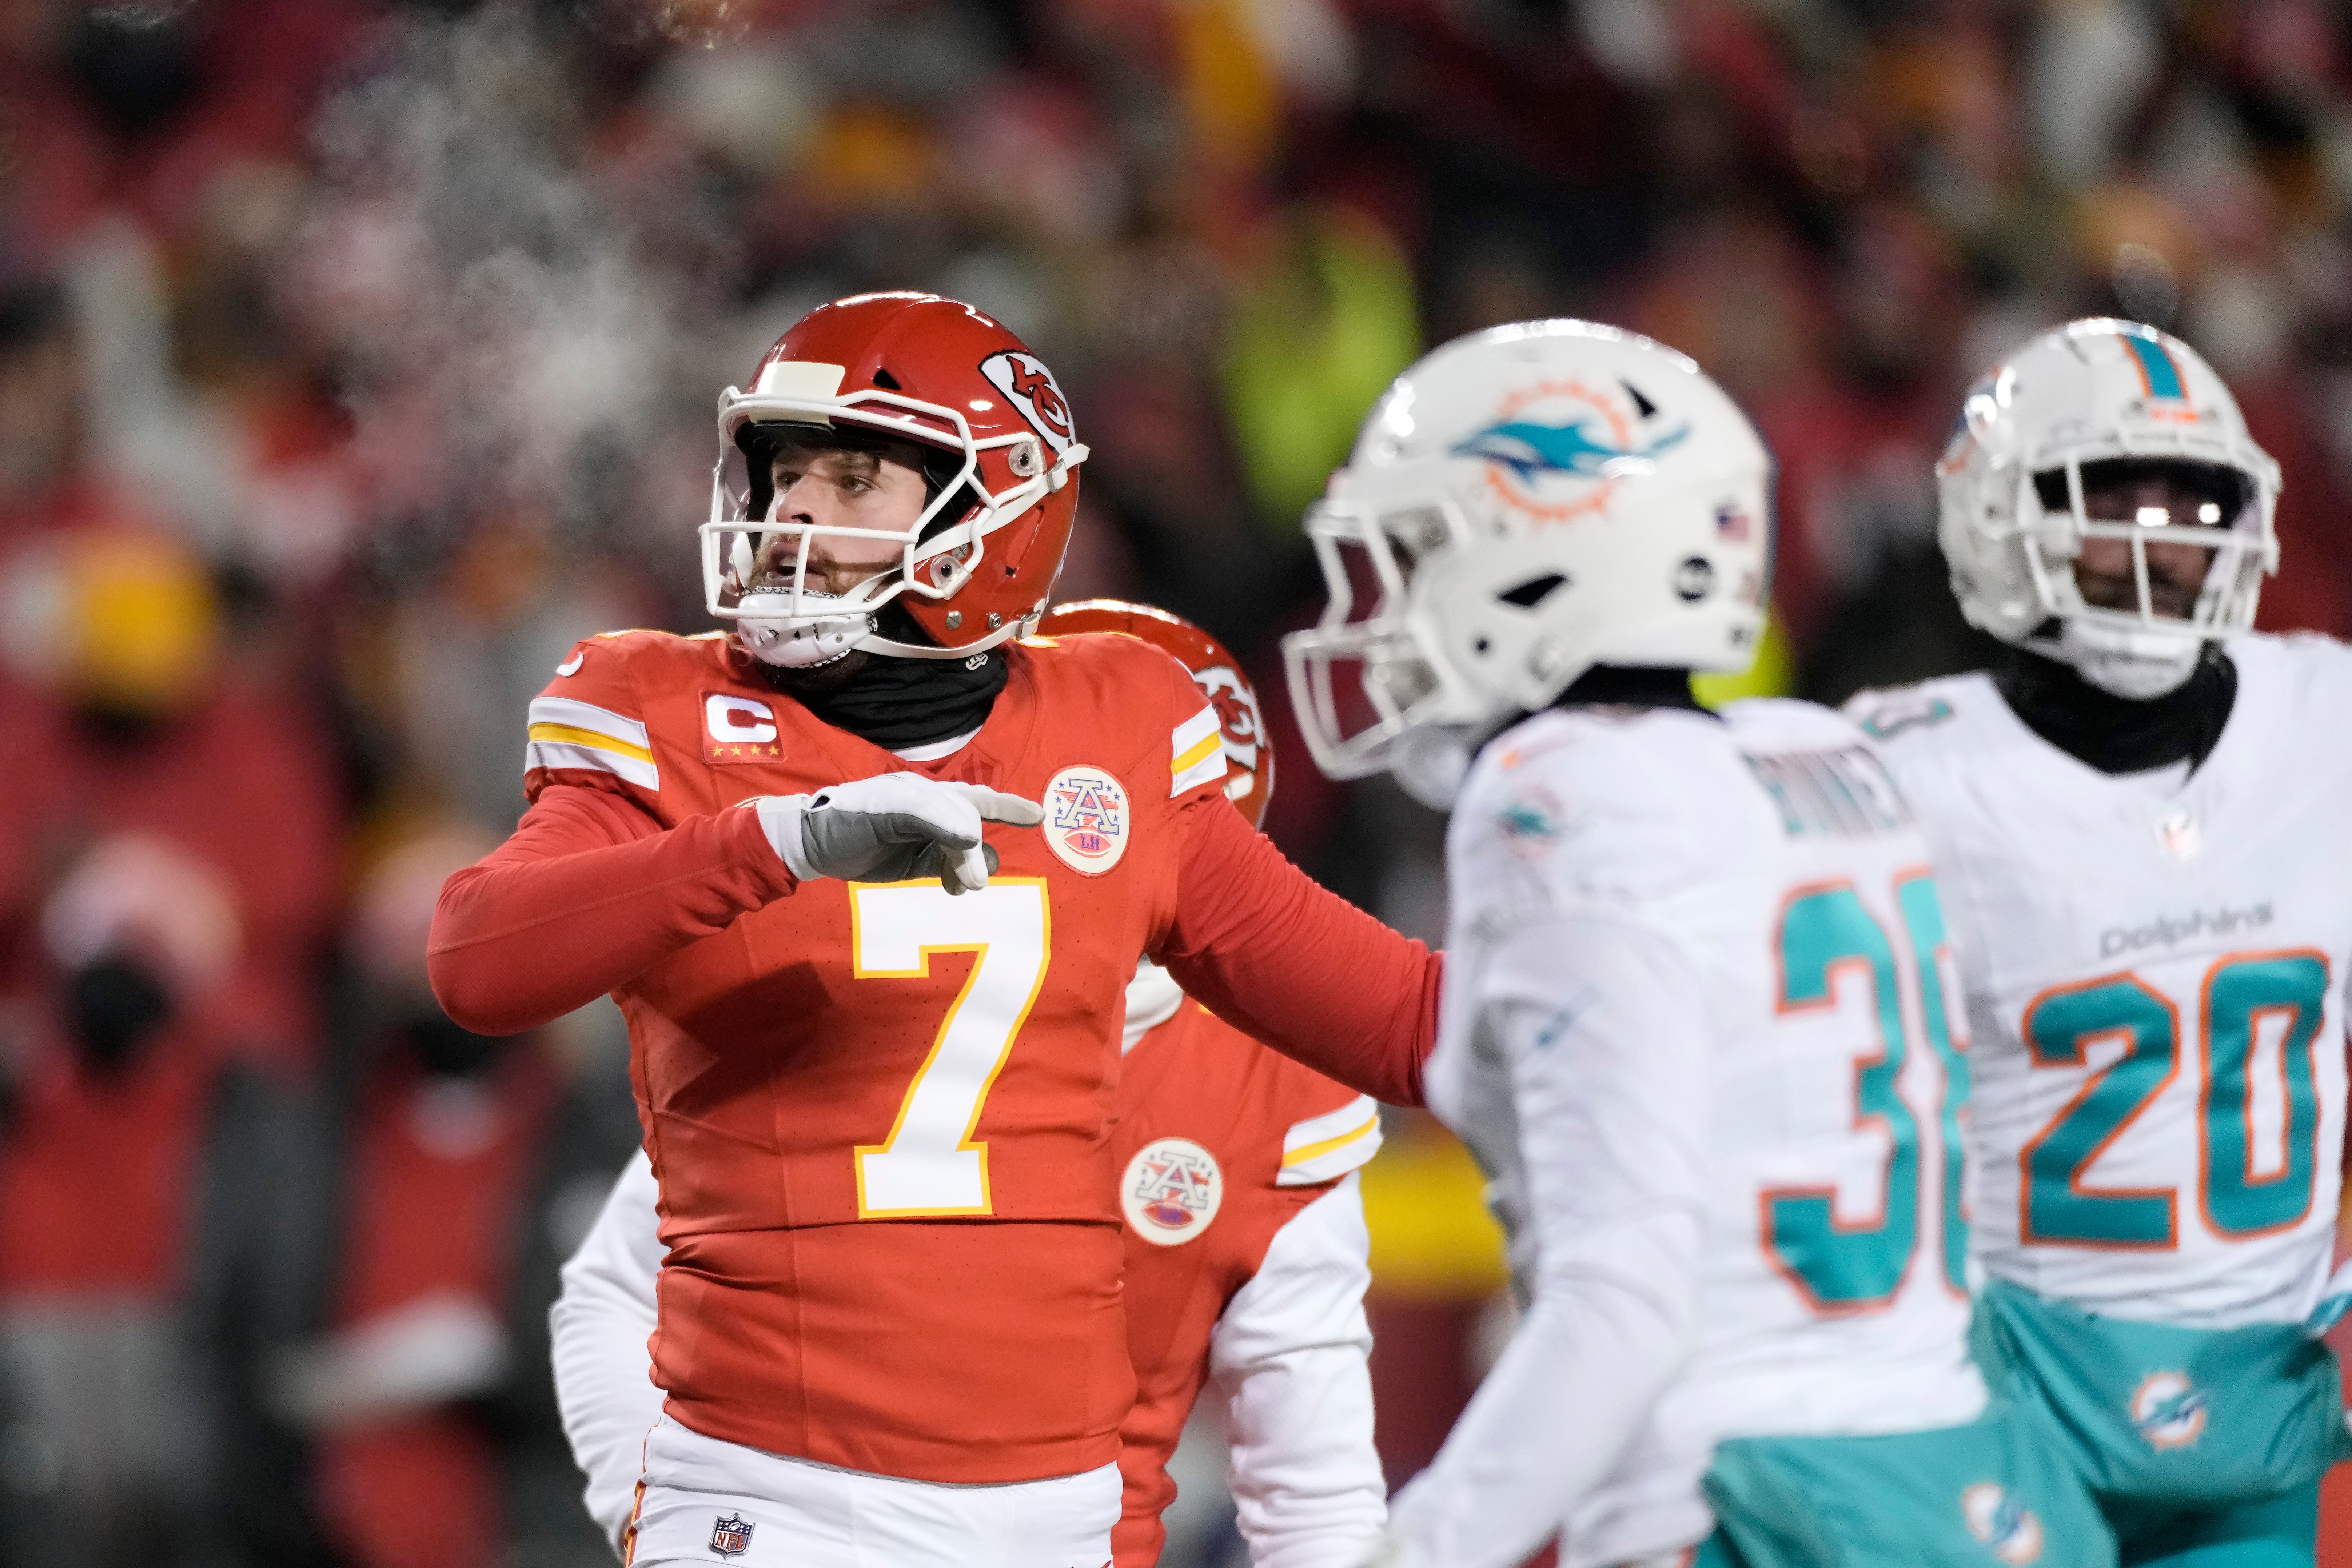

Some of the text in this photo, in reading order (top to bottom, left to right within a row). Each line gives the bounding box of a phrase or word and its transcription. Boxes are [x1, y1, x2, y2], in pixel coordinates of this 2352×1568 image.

[706, 694, 778, 744] C
[1080, 835, 1100, 850] LH
[848, 877, 1051, 1219] 7
[2020, 947, 2329, 1252] 20
[715, 1532, 744, 1551] NFL
